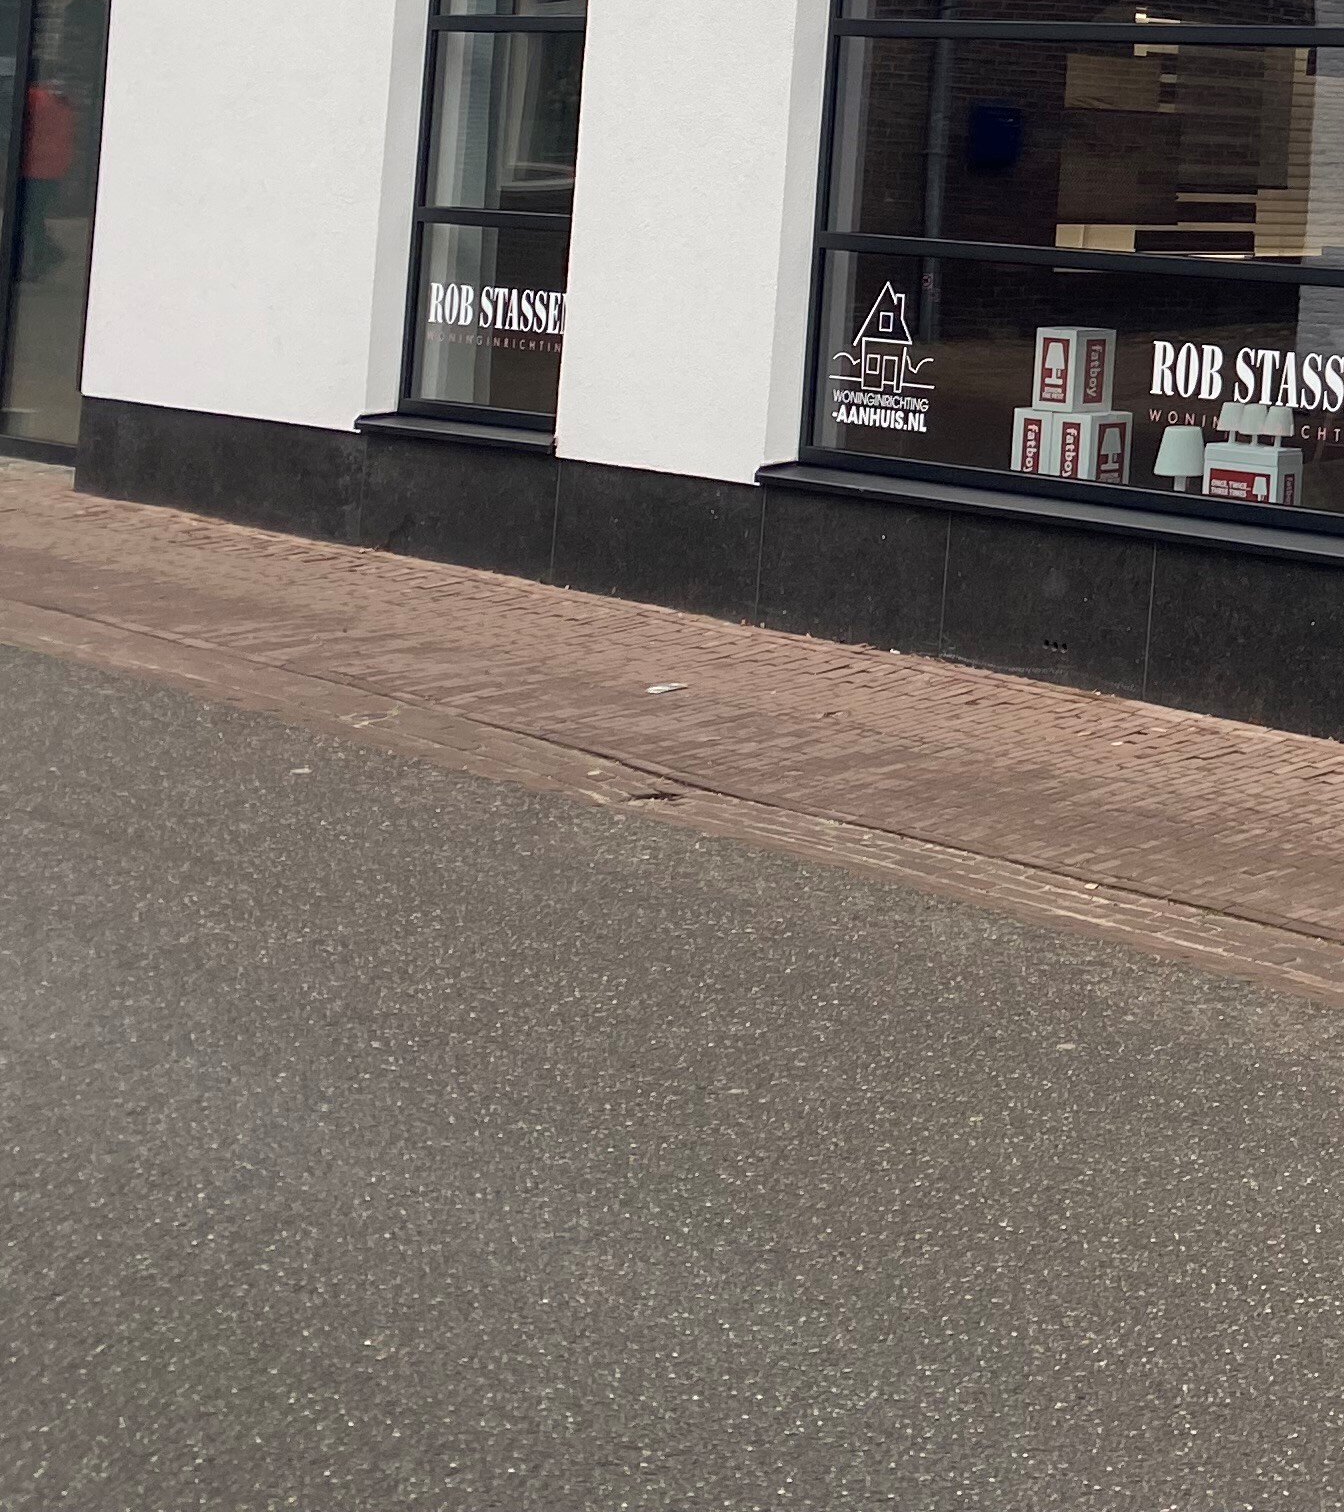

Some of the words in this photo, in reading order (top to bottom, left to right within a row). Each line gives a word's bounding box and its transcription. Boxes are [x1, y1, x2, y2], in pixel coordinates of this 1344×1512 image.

[427, 282, 474, 326] ROB
[427, 331, 561, 353] WONINGINRICHTIN
[1086, 344, 1103, 397] fatboy
[1150, 340, 1224, 400] ROB
[832, 389, 929, 413] WONINGINRICHTING
[831, 406, 928, 433] -AANHUIS.NL
